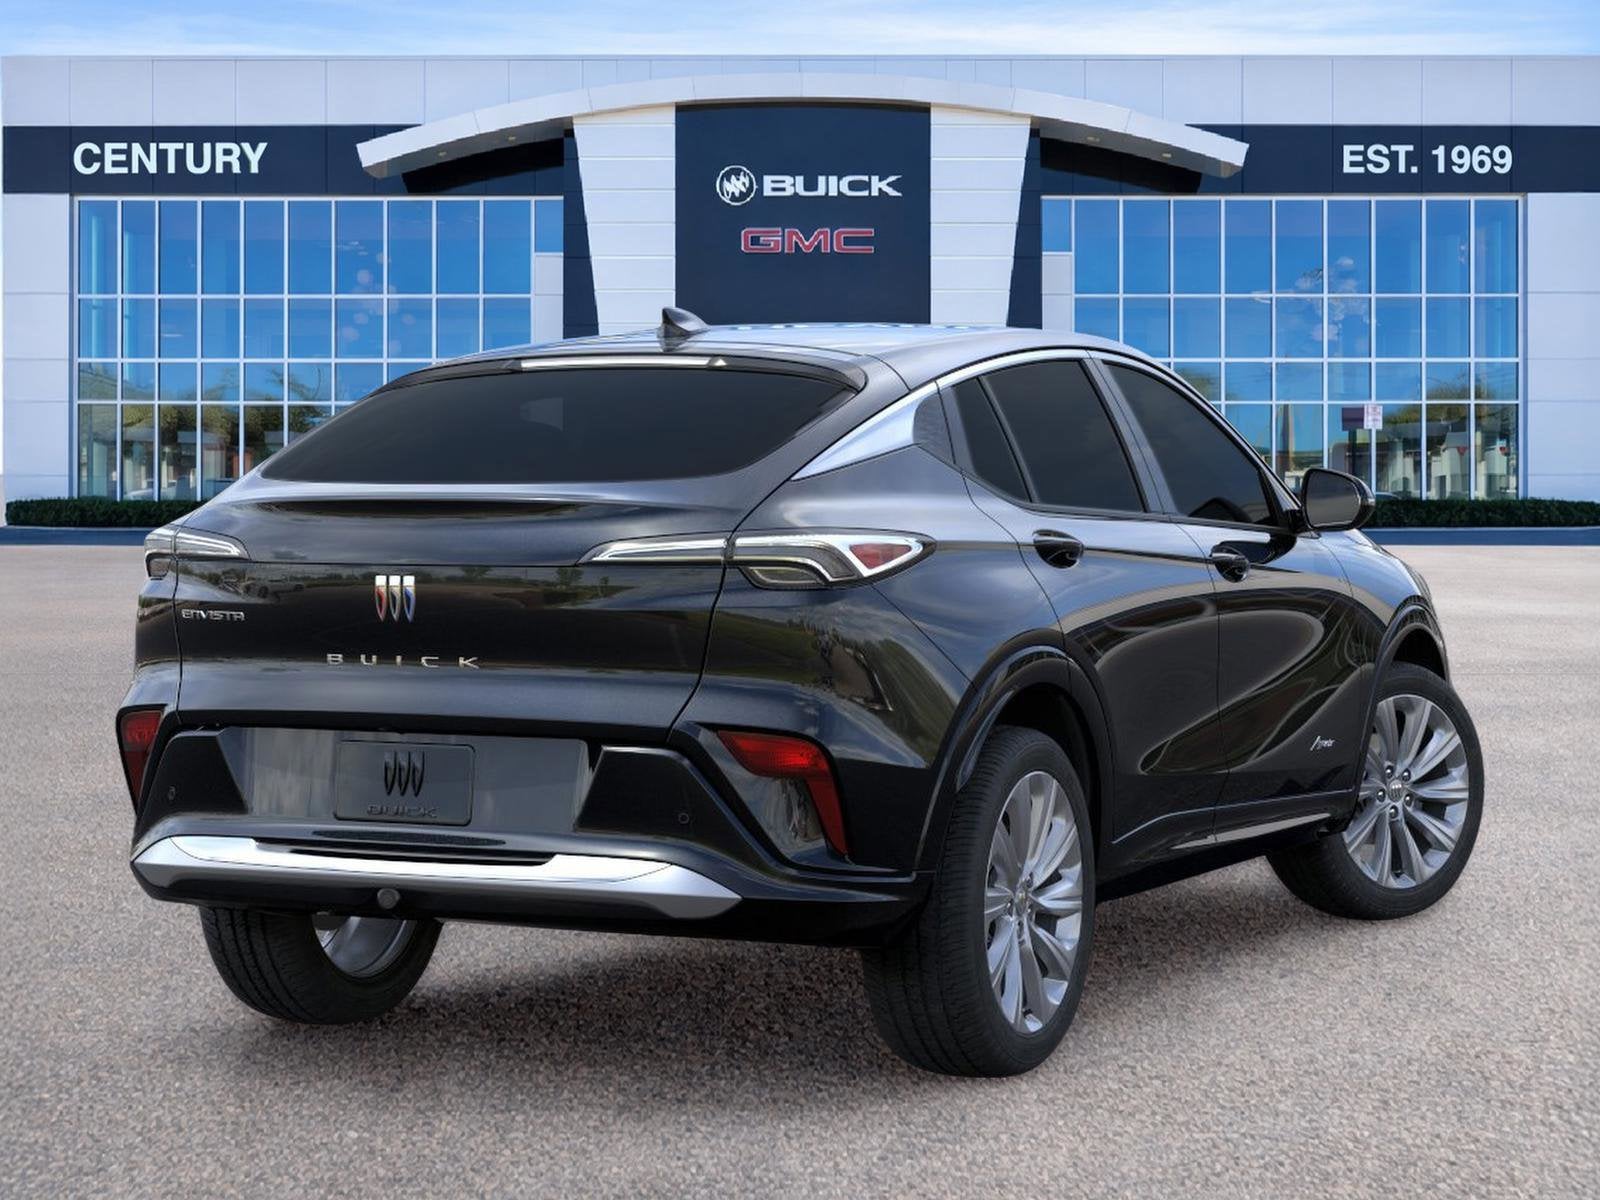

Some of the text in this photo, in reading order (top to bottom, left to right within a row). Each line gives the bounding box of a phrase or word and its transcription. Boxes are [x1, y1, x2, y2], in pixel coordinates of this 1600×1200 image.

[73, 142, 267, 174] CENTURY
[1342, 144, 1513, 174] EST. 1969
[763, 175, 902, 197] BUICK
[741, 227, 874, 253] GMC
[181, 608, 245, 621] ENVISTA
[326, 653, 480, 669] BUICK
[367, 804, 439, 818] BUICK
